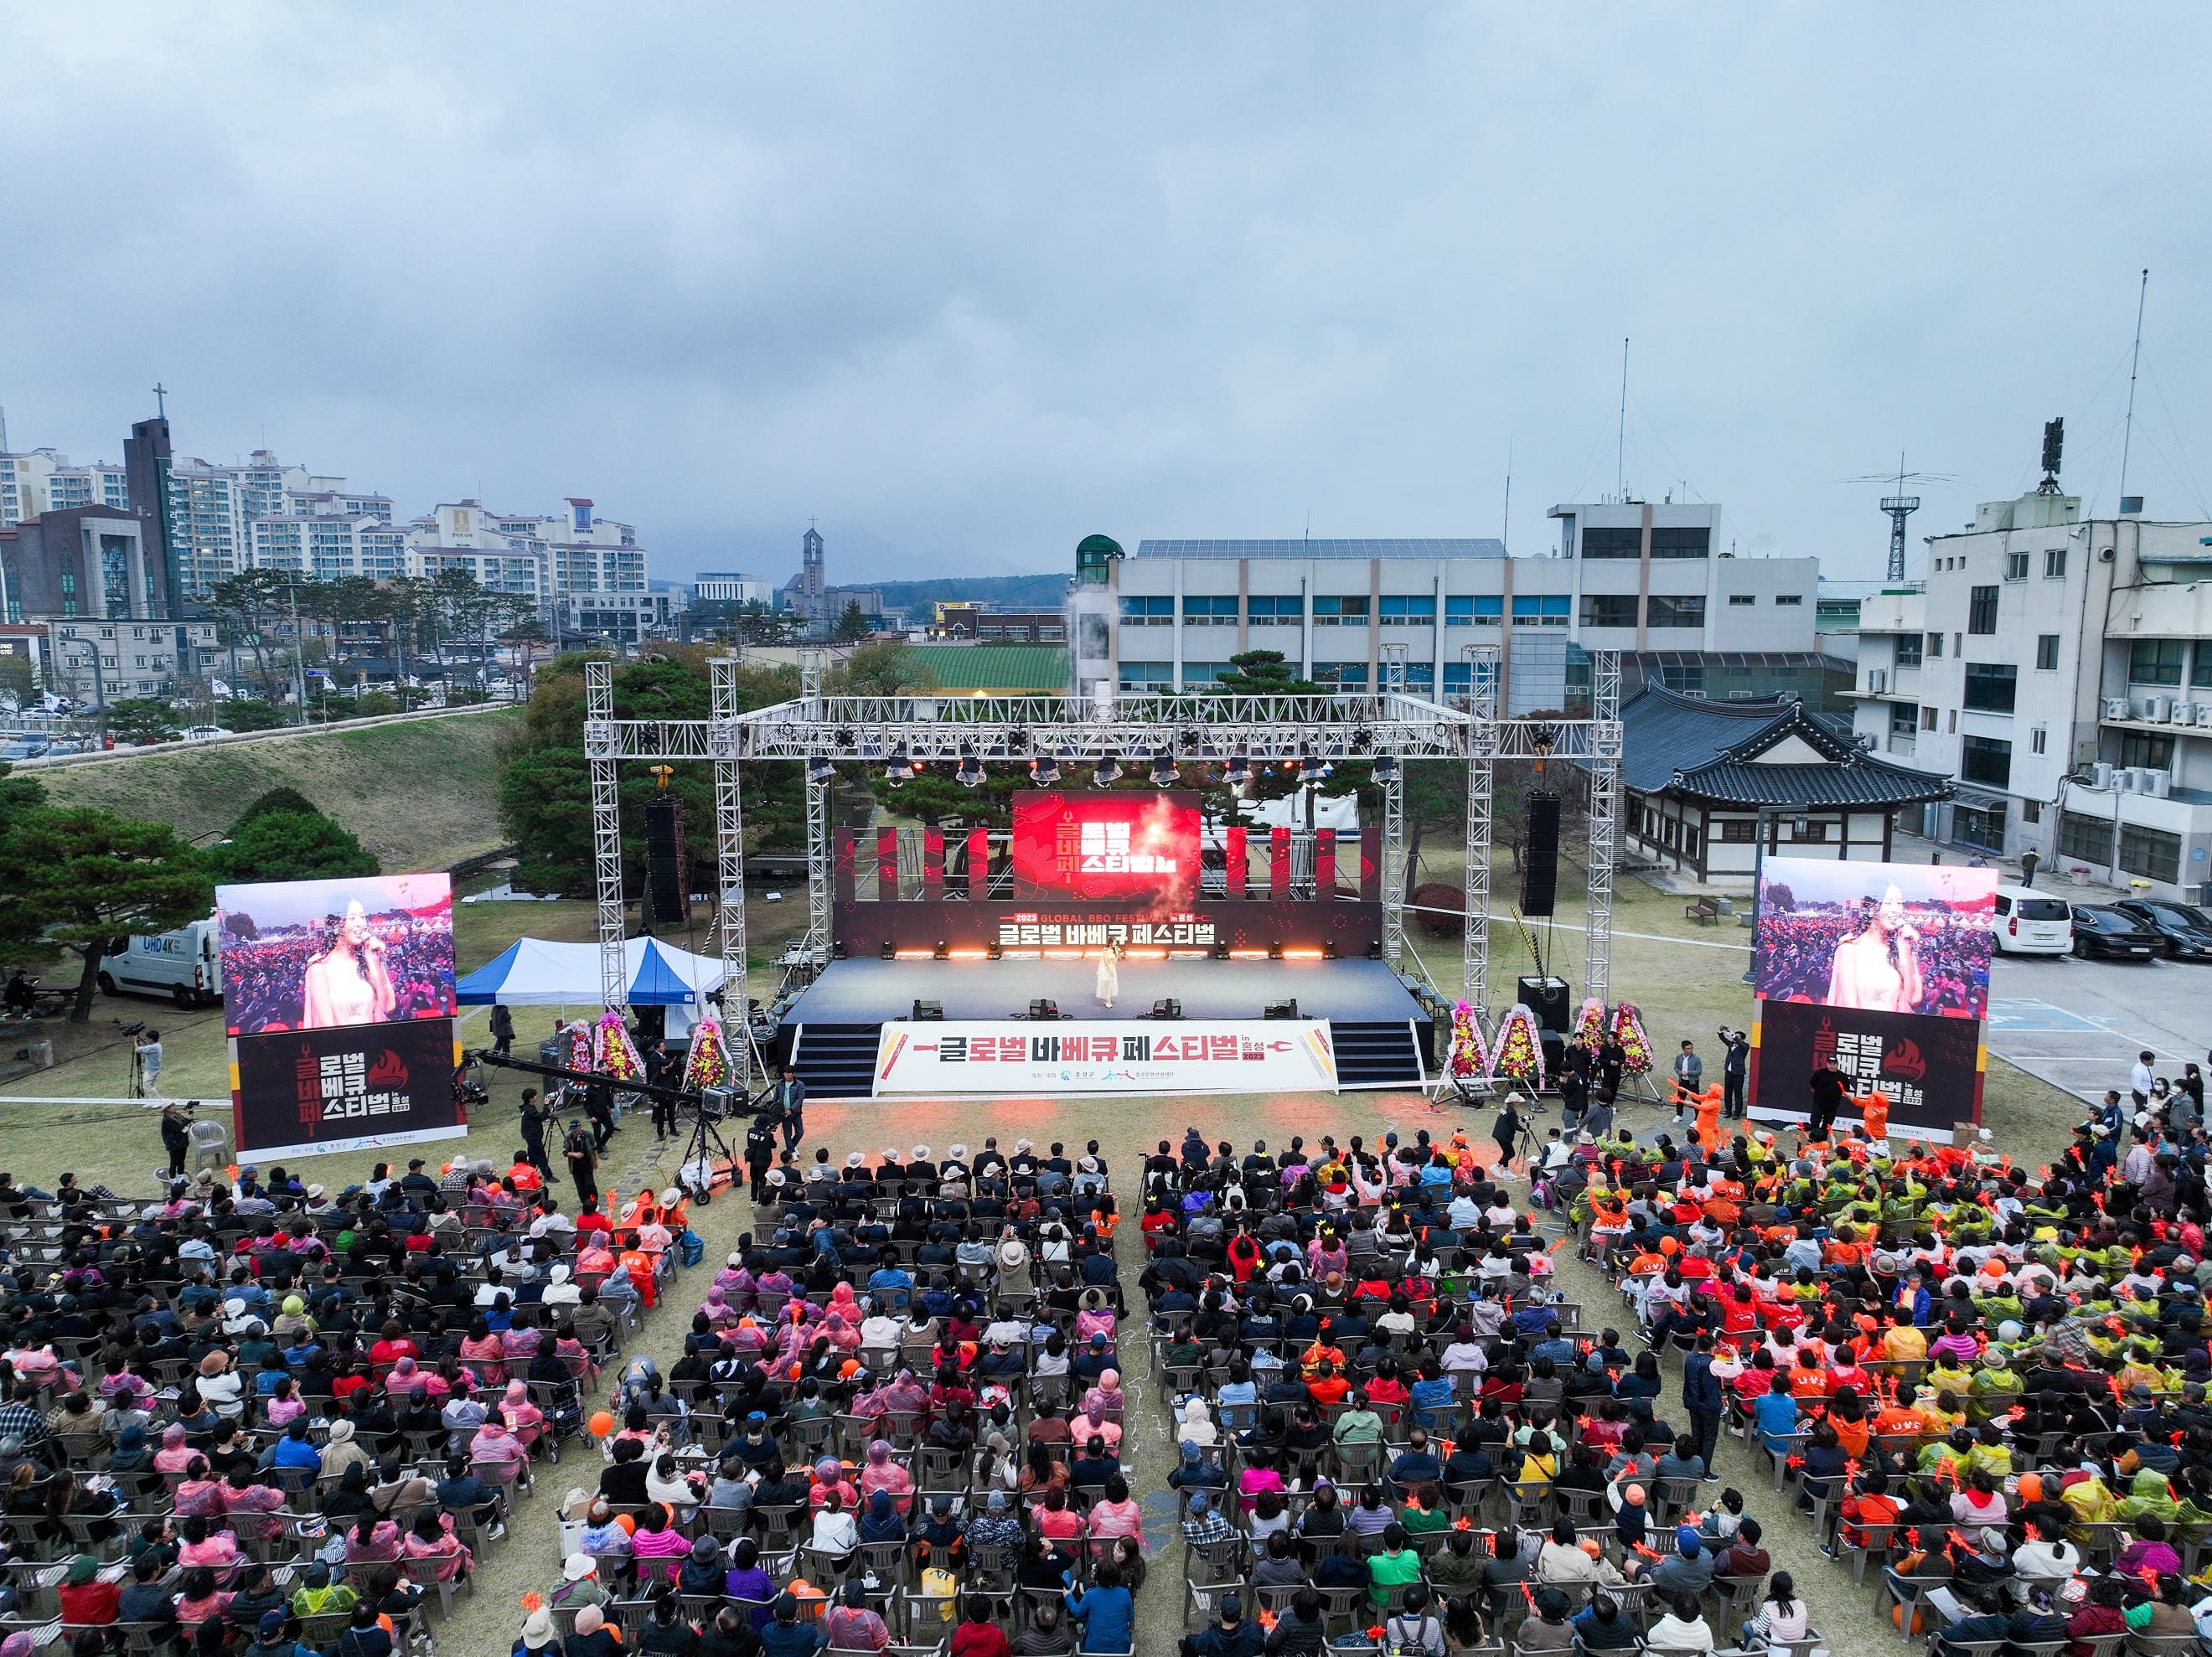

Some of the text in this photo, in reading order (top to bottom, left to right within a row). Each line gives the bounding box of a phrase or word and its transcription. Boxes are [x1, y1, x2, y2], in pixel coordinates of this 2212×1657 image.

[1057, 822, 1130, 839] 글로벌
[1057, 855, 1155, 873] 페스티벌
[1016, 914, 1037, 922] 2023
[1041, 914, 1083, 923] GLOBAL
[1089, 914, 1111, 923] BBQ
[1115, 914, 1165, 923] FESTIVAL
[1178, 913, 1194, 922] 홍성
[999, 924, 1215, 945] 글로벌 바베큐 페스티벌
[143, 936, 162, 952] UHD
[163, 937, 173, 954] 4K
[940, 1036, 1026, 1062] 글로벌
[1032, 1036, 1118, 1062] 바베큐
[1123, 1035, 1238, 1061] 페스티벌
[1242, 1041, 1264, 1051] 홍성
[1814, 1030, 1883, 1056] 글로벌
[296, 1052, 365, 1080] 글로벌
[297, 1074, 367, 1101] 바베큐
[1904, 1088, 1923, 1097] 홍성
[299, 1092, 390, 1123] 페스티벌
[392, 1096, 410, 1104] 홍성
[749, 1133, 765, 1142] STAF
[1797, 1376, 1827, 1387] 나상도
[1892, 1420, 1920, 1431] 나상도
